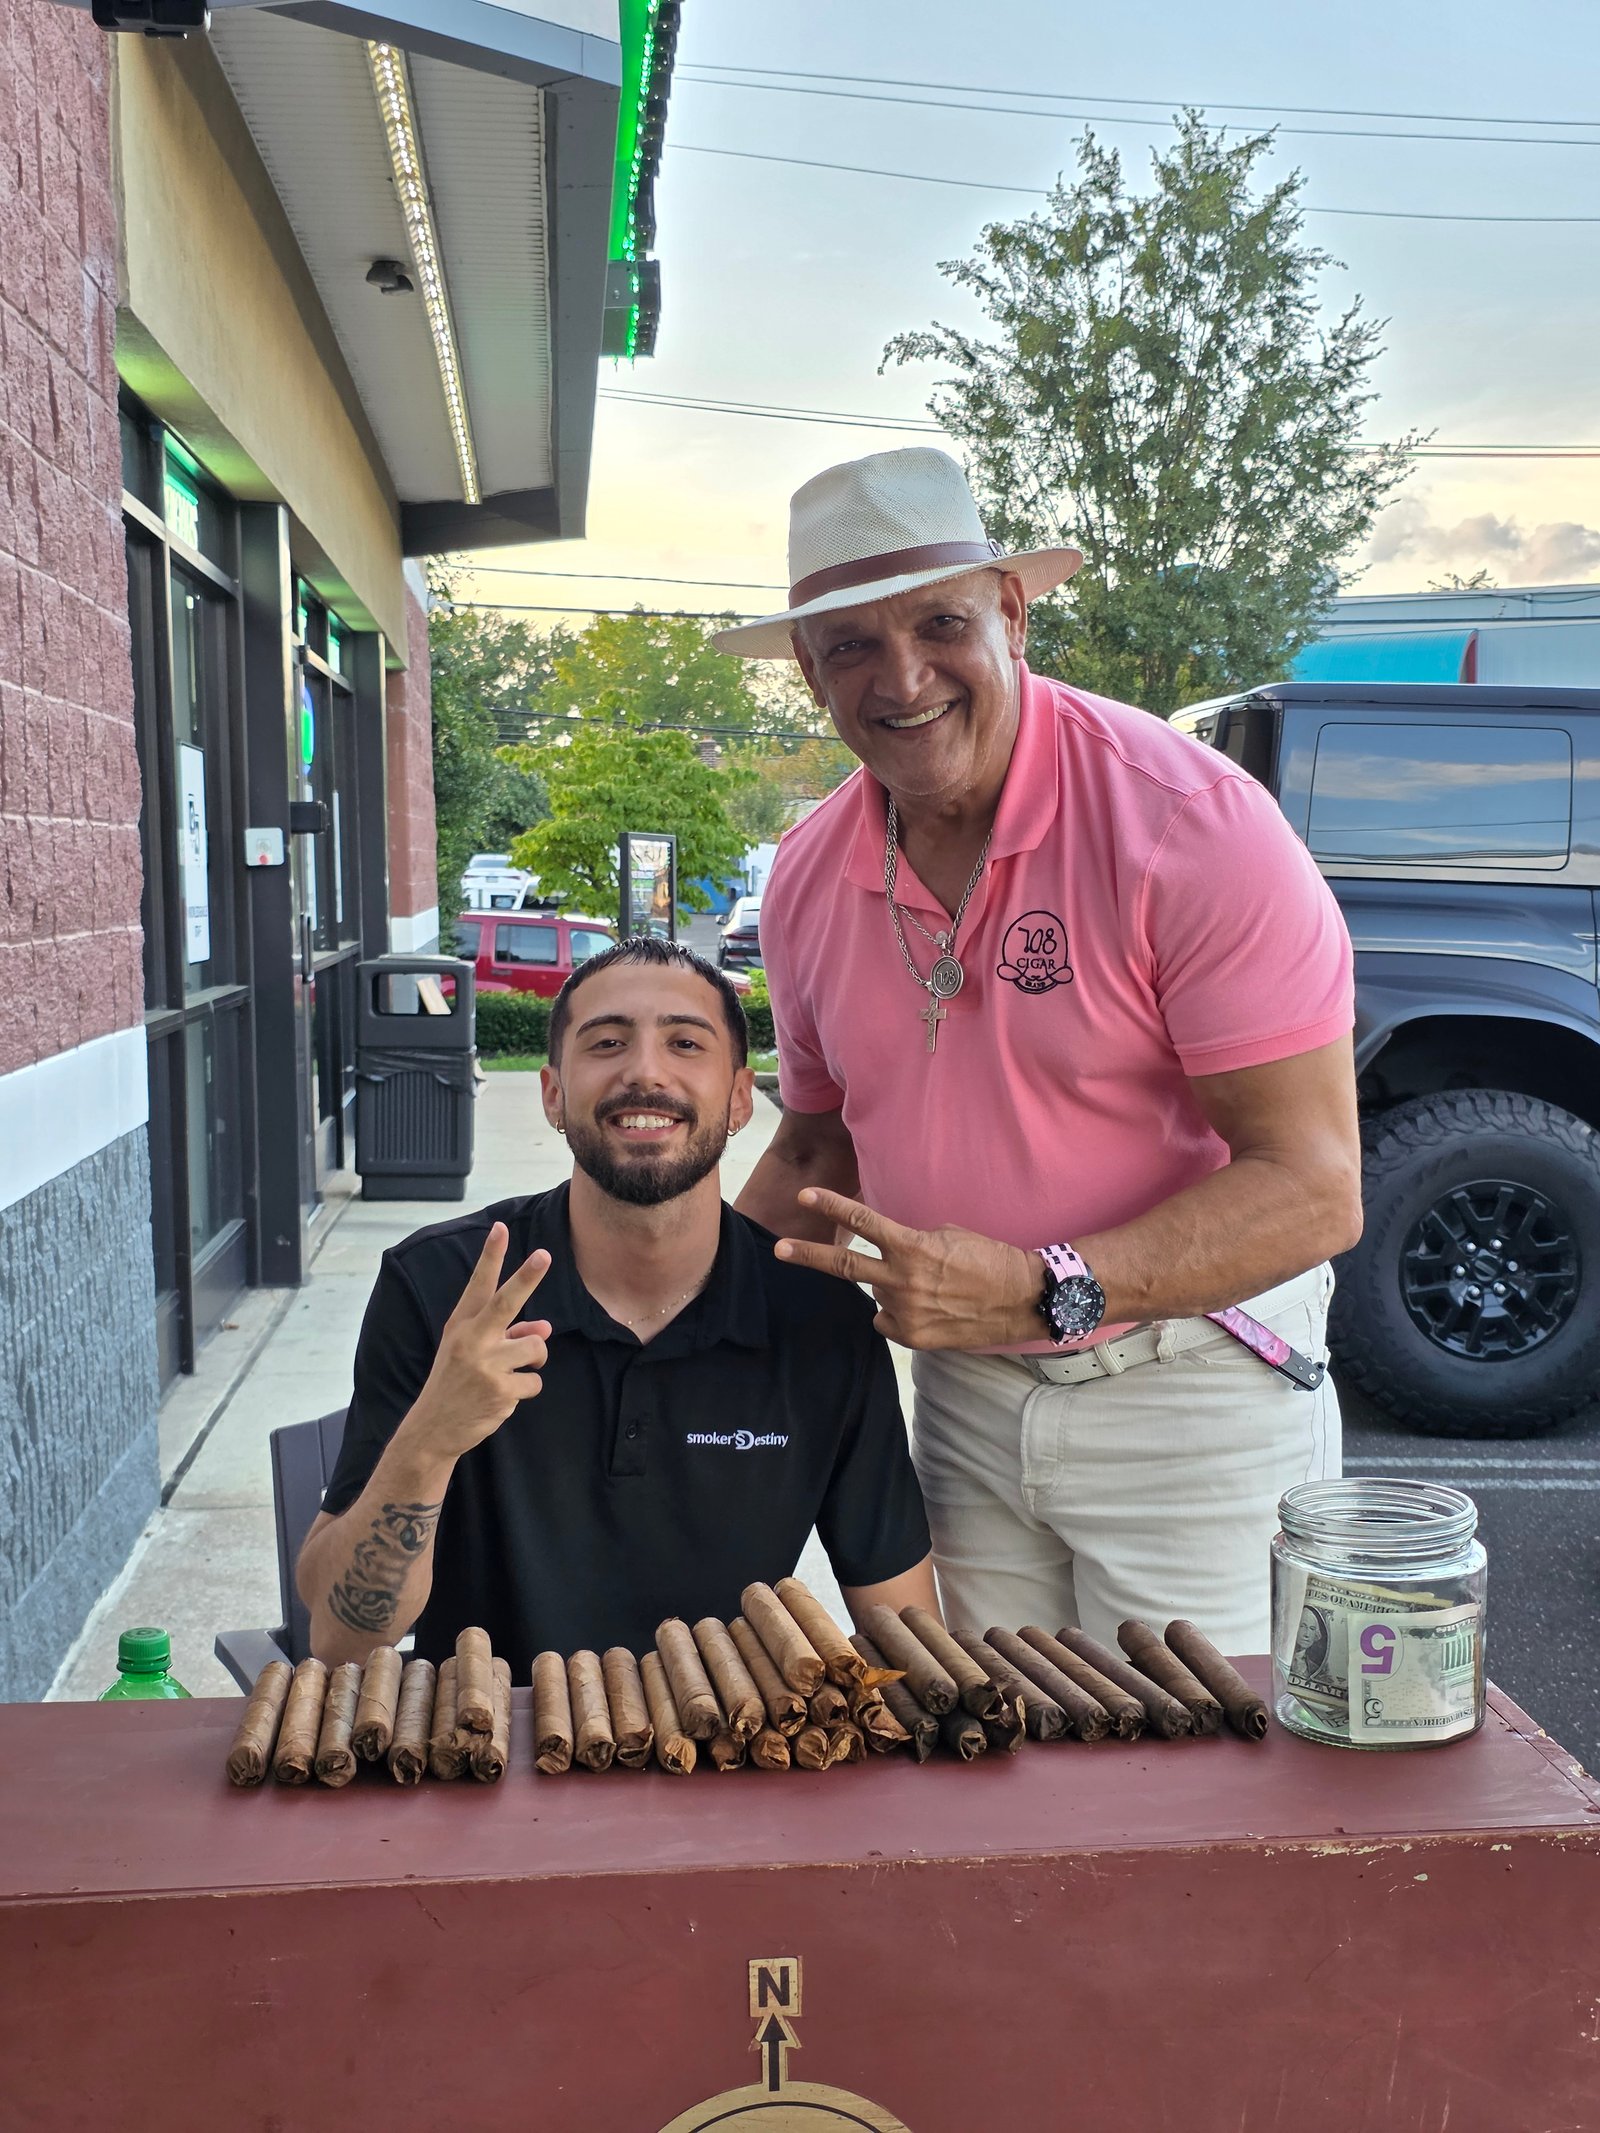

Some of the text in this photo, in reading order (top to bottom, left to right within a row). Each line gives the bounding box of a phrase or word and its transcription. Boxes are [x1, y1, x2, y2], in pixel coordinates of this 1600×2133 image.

[1018, 926, 1057, 955] 708
[1016, 957, 1056, 970] CIGAR
[1360, 1624, 1397, 1675] 5
[1364, 1698, 1384, 1726] 5
[758, 1966, 790, 2008] N
